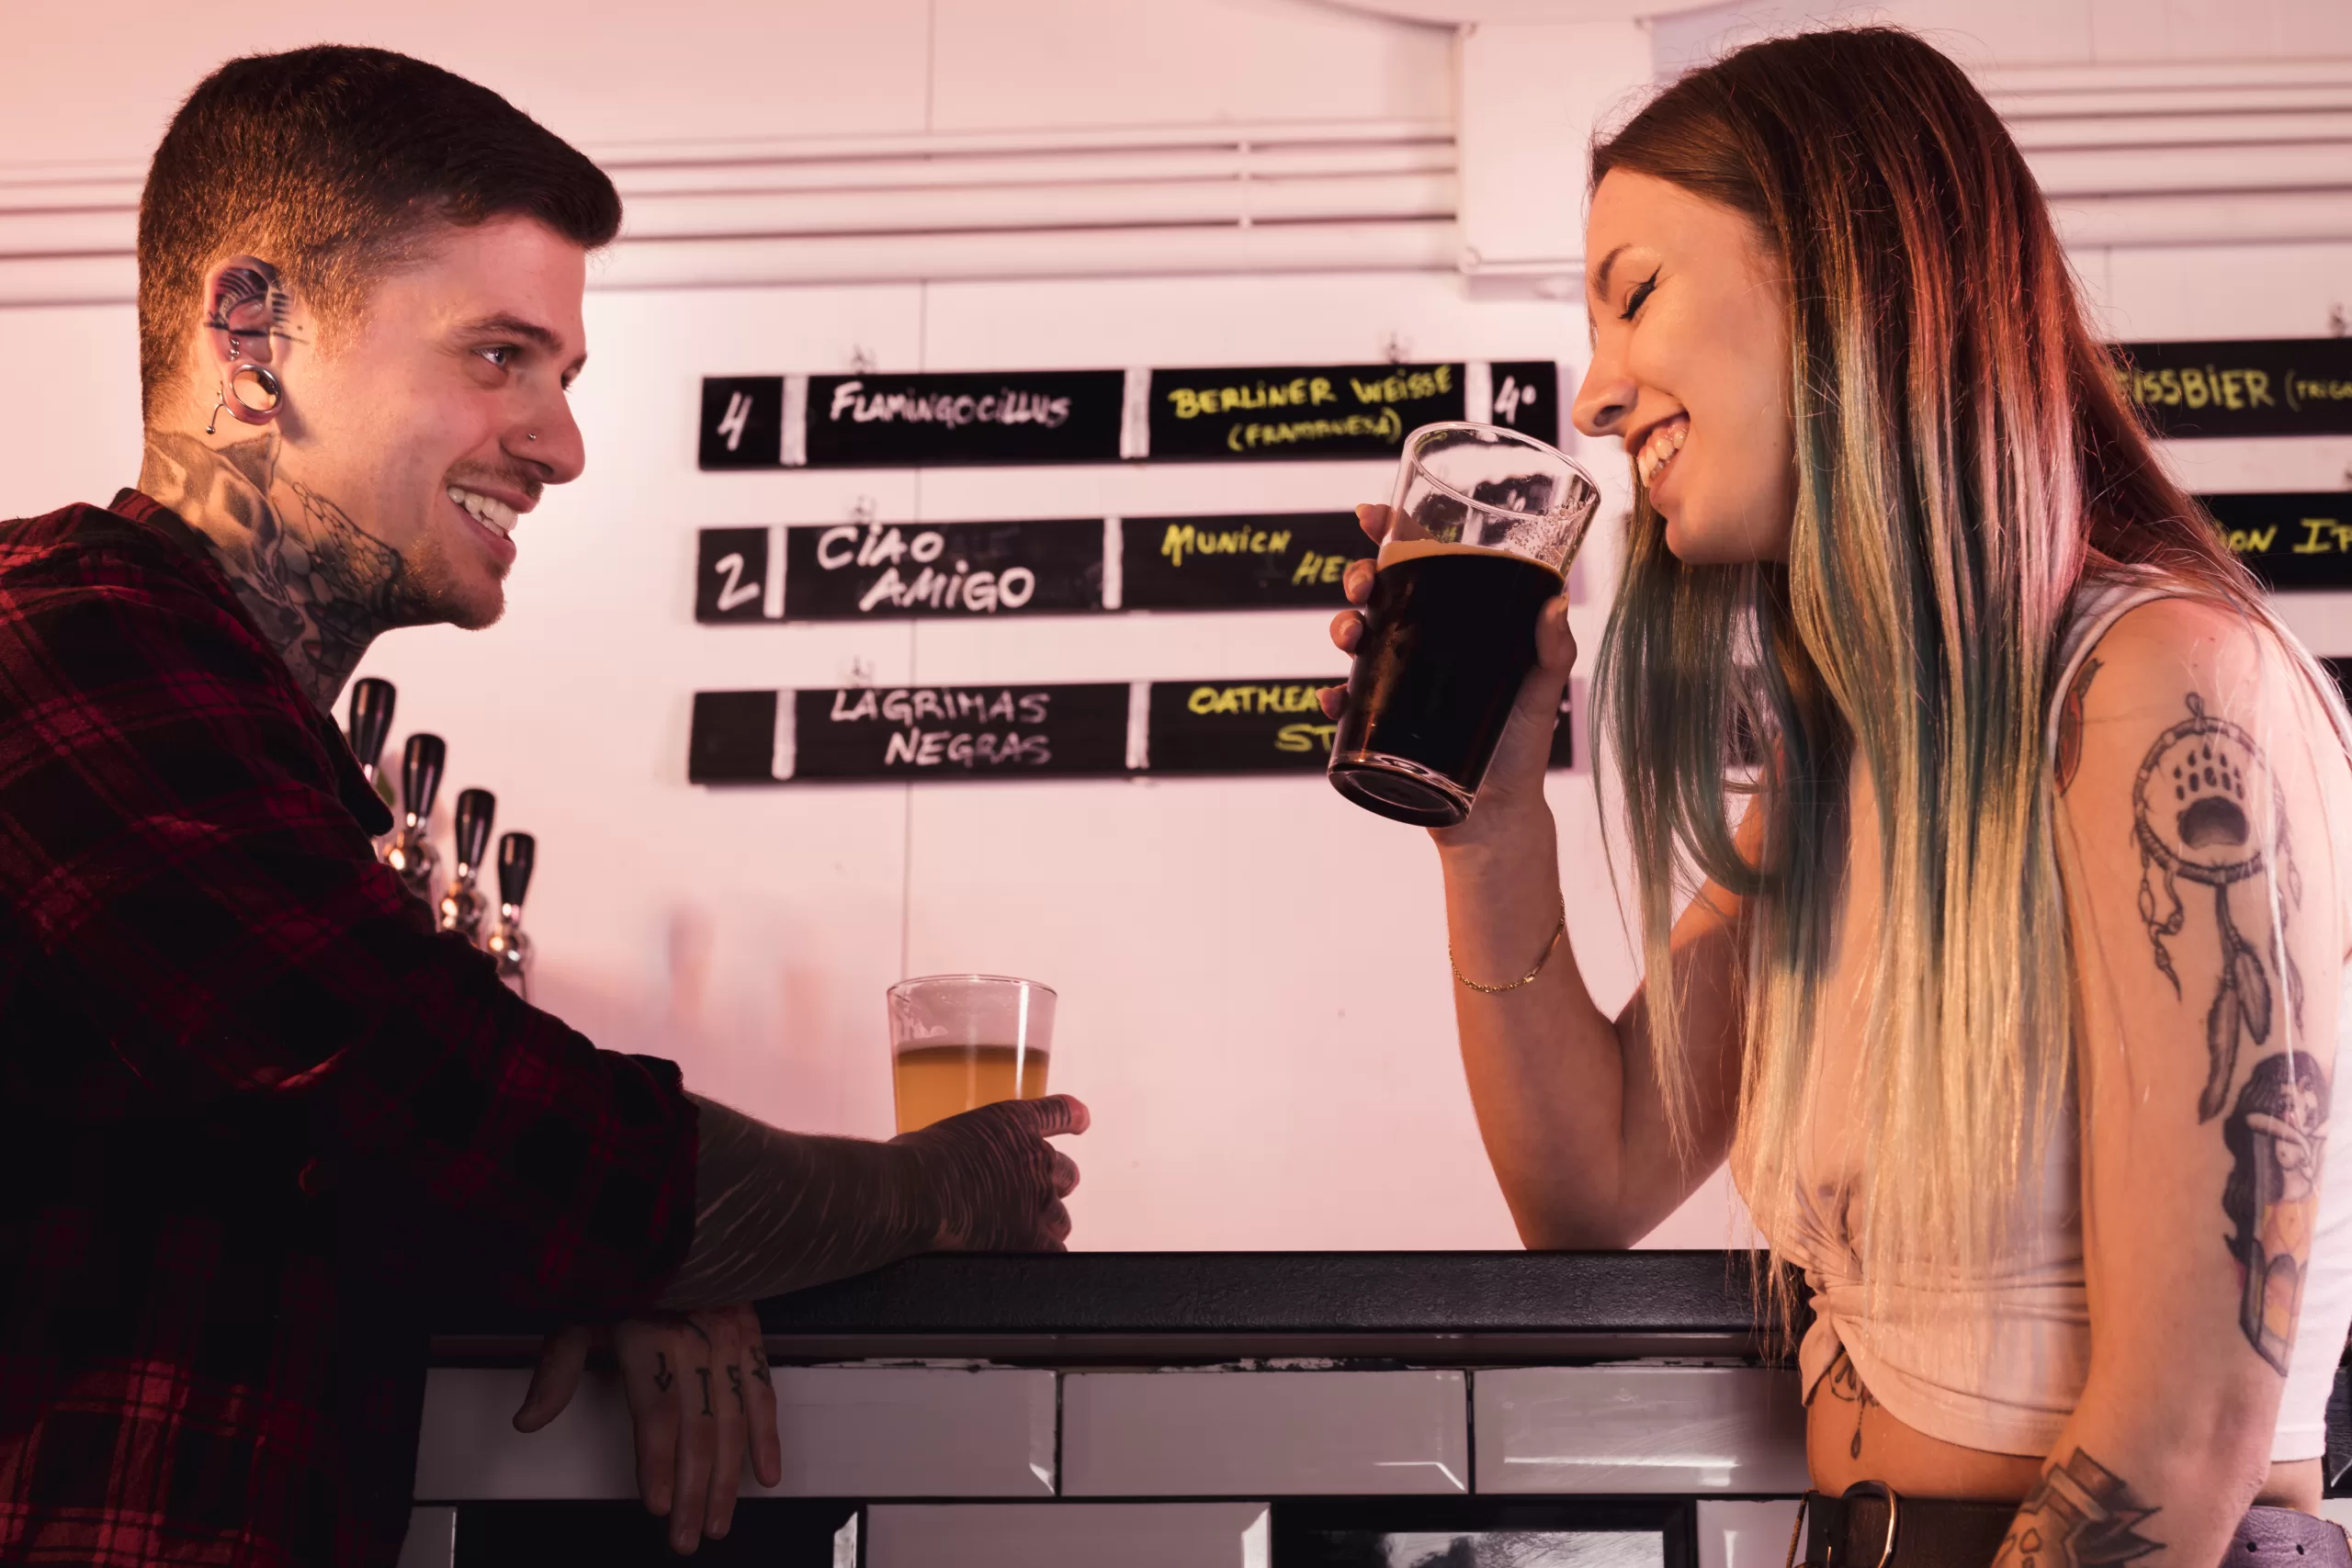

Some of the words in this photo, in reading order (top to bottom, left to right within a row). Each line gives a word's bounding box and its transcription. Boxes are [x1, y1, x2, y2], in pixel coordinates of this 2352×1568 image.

[1168, 378, 1337, 419] BERLINER
[718, 391, 752, 450] 4
[818, 523, 944, 569] CIAO
[1161, 524, 1292, 567] MUNICH
[716, 553, 760, 611] 2
[858, 561, 1035, 613] AMIGO
[1292, 550, 1349, 585] HE
[1188, 684, 1329, 715] OATMEA
[884, 727, 1052, 768] NEGRAS
